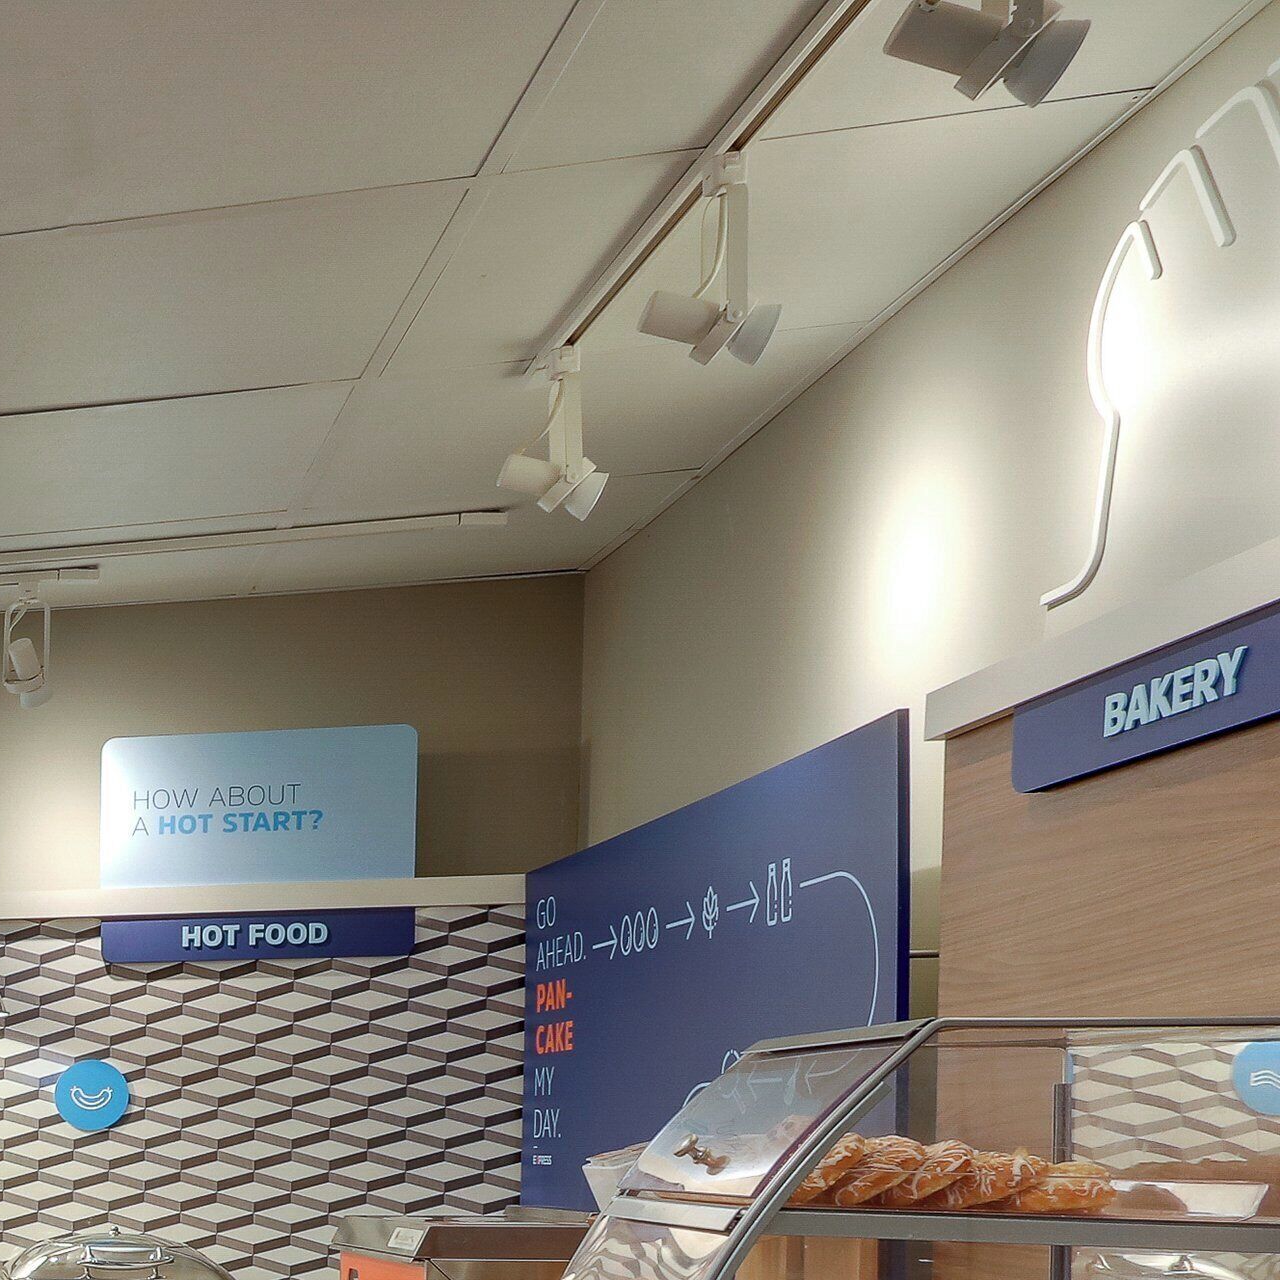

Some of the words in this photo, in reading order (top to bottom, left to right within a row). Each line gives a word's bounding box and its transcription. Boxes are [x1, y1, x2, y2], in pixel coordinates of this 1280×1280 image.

[1103, 645, 1249, 738] BAKERY
[133, 787, 199, 811] HOW
[208, 783, 302, 808] ABOUT
[132, 816, 149, 837] A
[158, 813, 213, 836] HOT
[222, 809, 324, 834] START?
[536, 896, 557, 930] GO
[181, 923, 241, 949] HOT
[248, 921, 329, 947] FOOD
[535, 931, 587, 972] AHEAD.
[536, 978, 573, 1014] PAN-
[535, 1020, 575, 1056] CAKE
[533, 1066, 556, 1097] MY
[532, 1108, 562, 1139] DAY.
